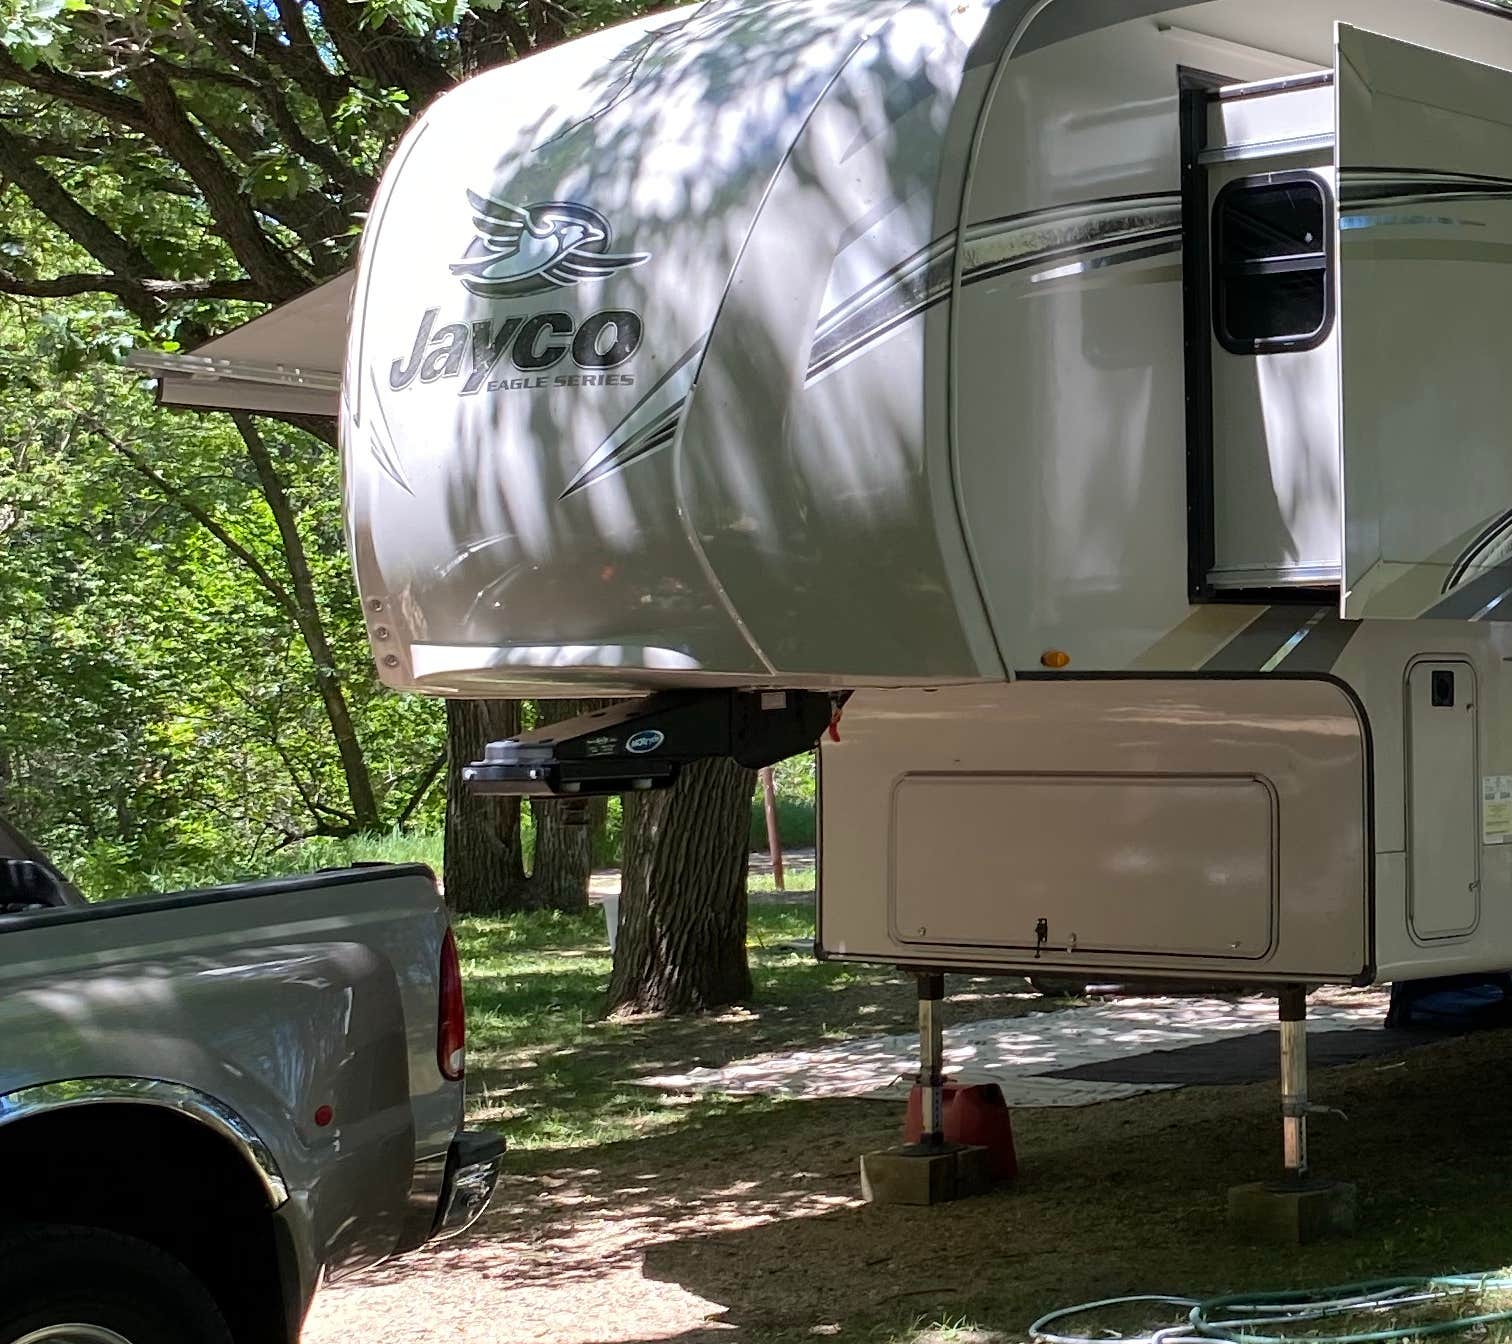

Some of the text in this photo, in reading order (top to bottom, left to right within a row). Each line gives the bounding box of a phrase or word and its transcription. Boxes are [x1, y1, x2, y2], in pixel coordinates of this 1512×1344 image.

[389, 306, 645, 397] Jayco
[487, 374, 635, 392] EAGLE SERIES
